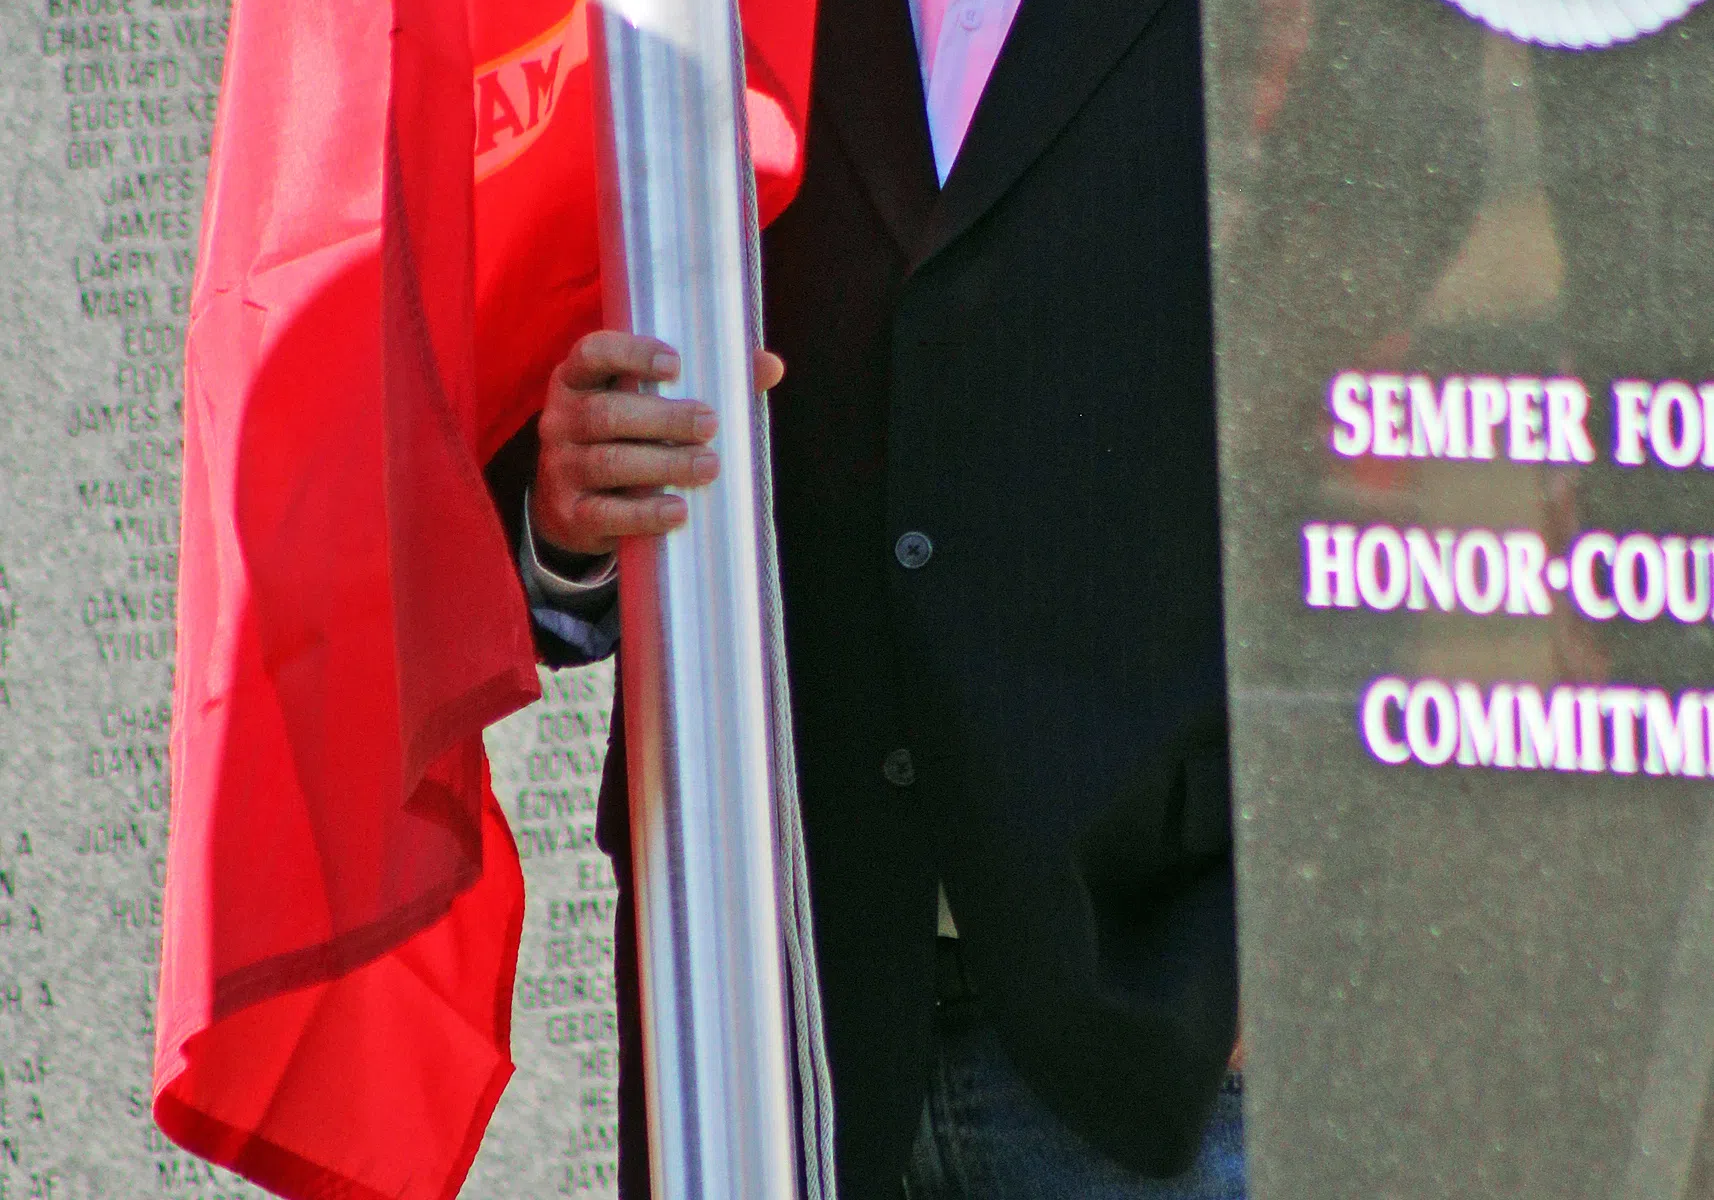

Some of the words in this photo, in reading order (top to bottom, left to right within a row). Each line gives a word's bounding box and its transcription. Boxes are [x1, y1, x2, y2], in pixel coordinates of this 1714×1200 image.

[40, 18, 161, 57] CHARLES
[63, 54, 179, 95] EDWARD
[67, 94, 173, 132] EUGENE
[66, 136, 115, 170] GUY
[101, 167, 196, 206] JAMES
[99, 207, 193, 245] JAMES
[73, 249, 158, 283] LARRY
[80, 285, 153, 321] MARY
[66, 403, 161, 438] JAMES
[1330, 370, 1595, 464] SEMPER
[1613, 379, 1714, 468] FO
[1362, 676, 1714, 779] COMMITM
[76, 821, 149, 856] JOHN
